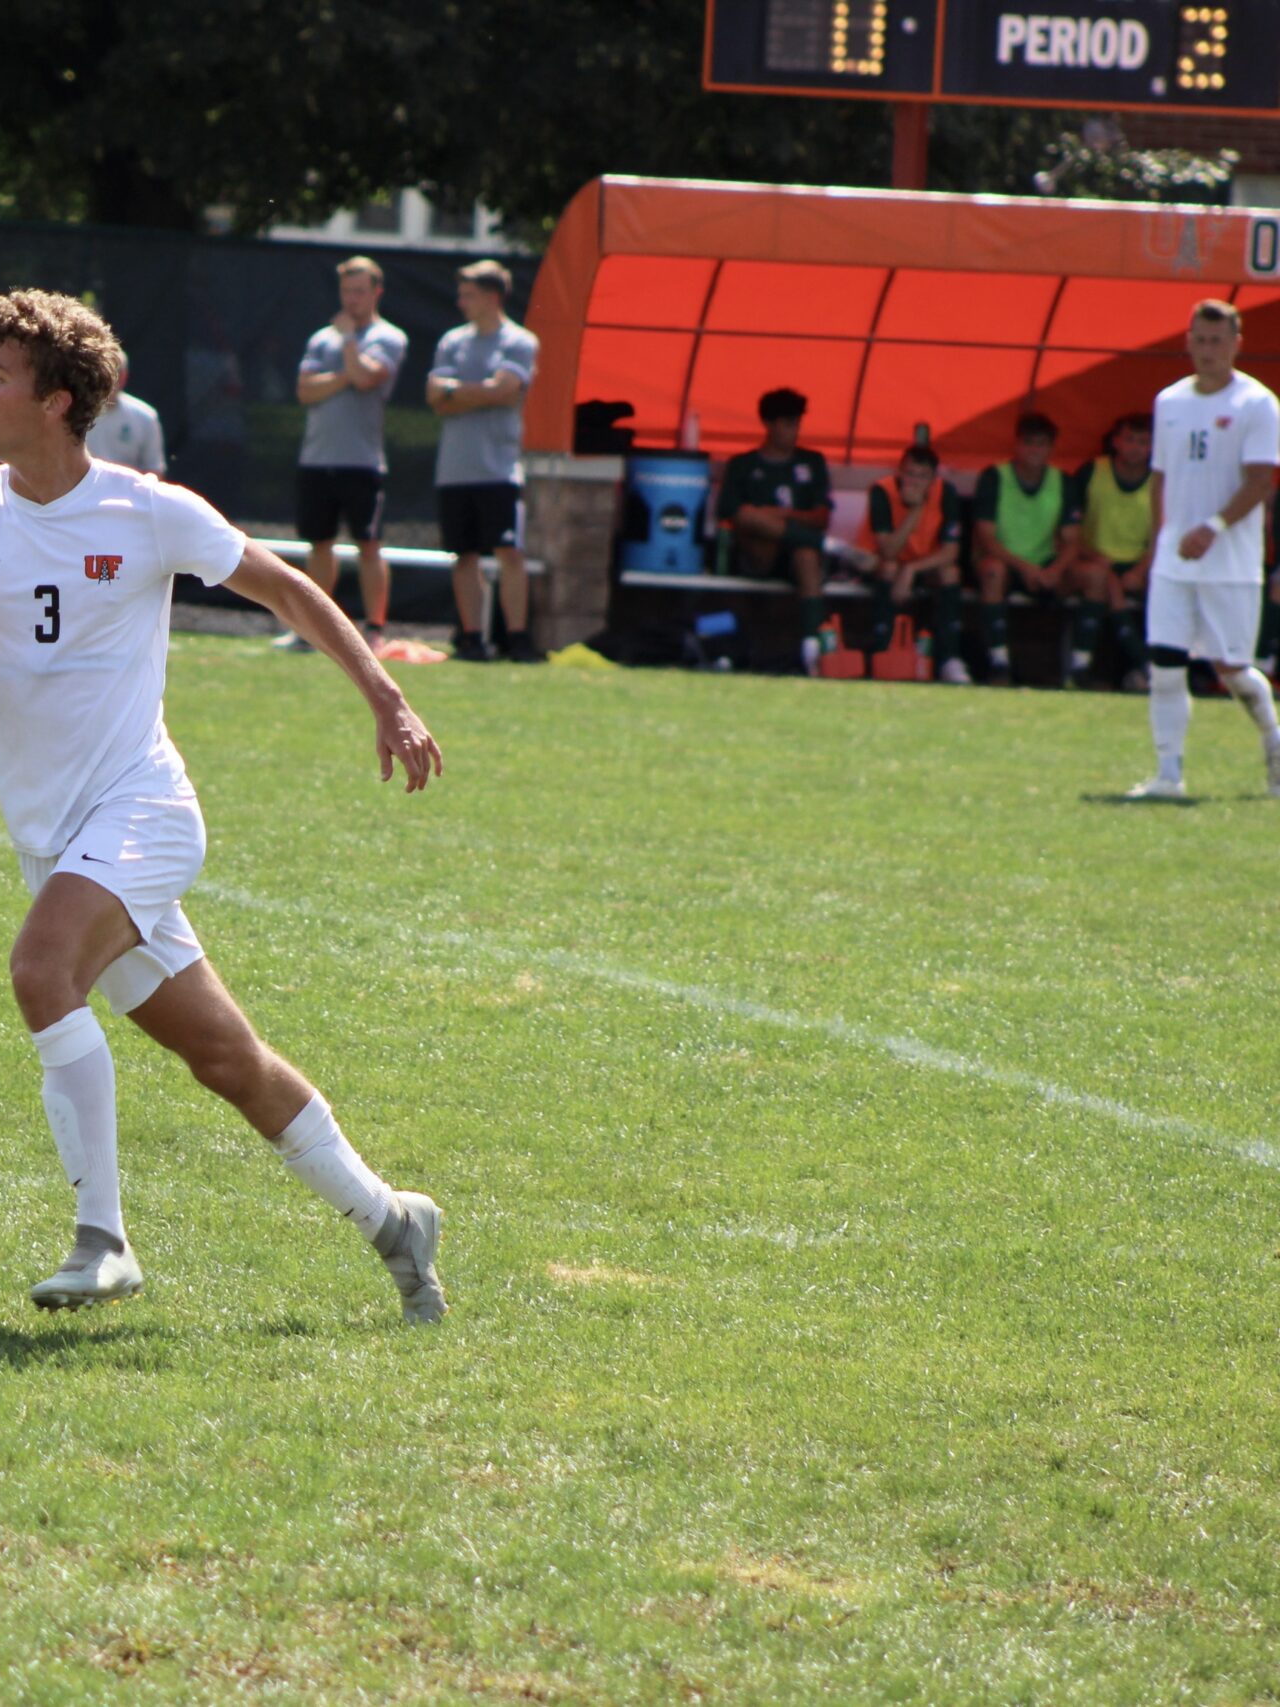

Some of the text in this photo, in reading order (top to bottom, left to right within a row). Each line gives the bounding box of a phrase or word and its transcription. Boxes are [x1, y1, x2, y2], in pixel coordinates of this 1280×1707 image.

[997, 7, 1228, 89] PERIOD 2
[1189, 430, 1208, 460] 16
[84, 555, 122, 580] UF
[34, 584, 60, 643] 3
